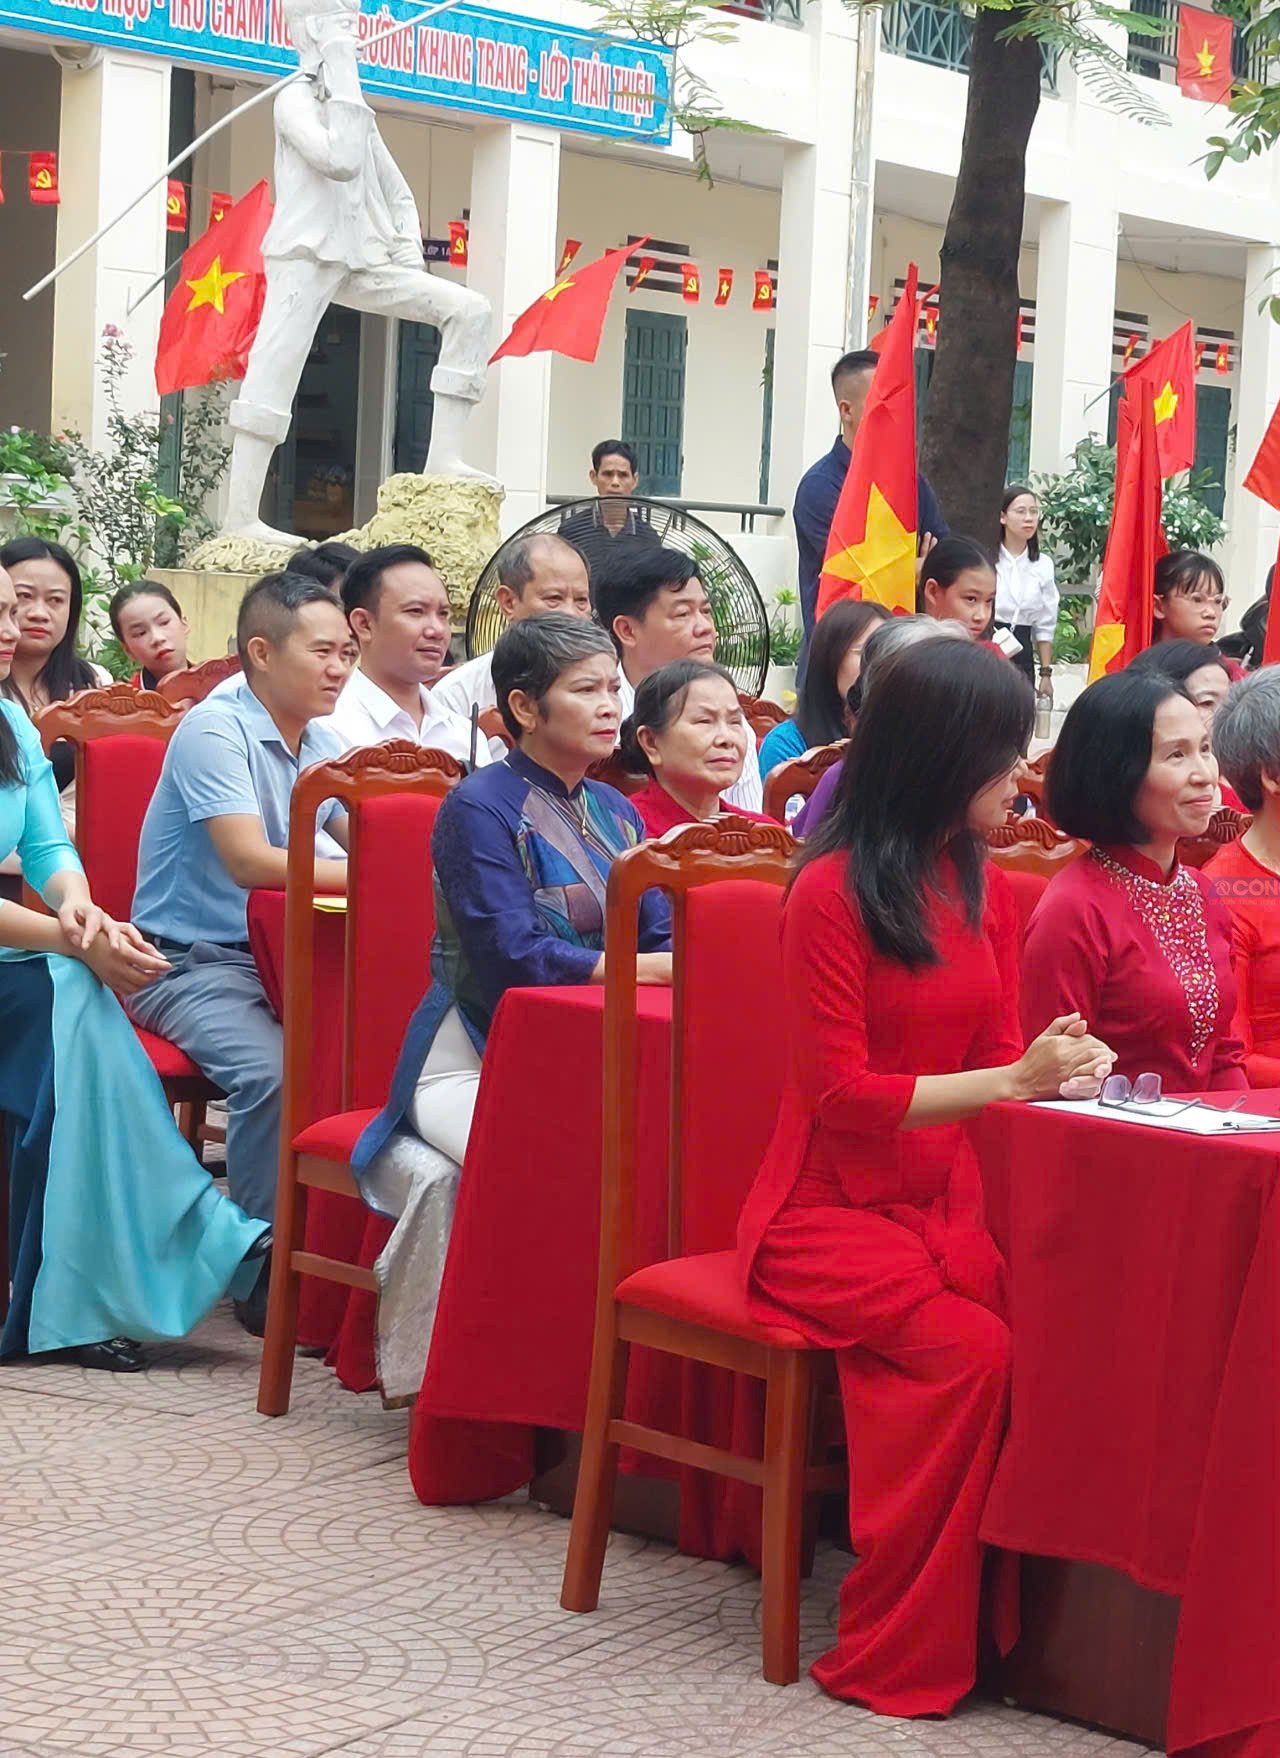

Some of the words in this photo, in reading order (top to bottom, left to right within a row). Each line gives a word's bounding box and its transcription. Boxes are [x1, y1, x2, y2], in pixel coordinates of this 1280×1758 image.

[418, 25, 473, 84] KHANG
[476, 38, 528, 94] TRANG
[539, 39, 570, 102] LỚP
[572, 51, 611, 110] THÂN
[613, 60, 656, 126] THIỆN
